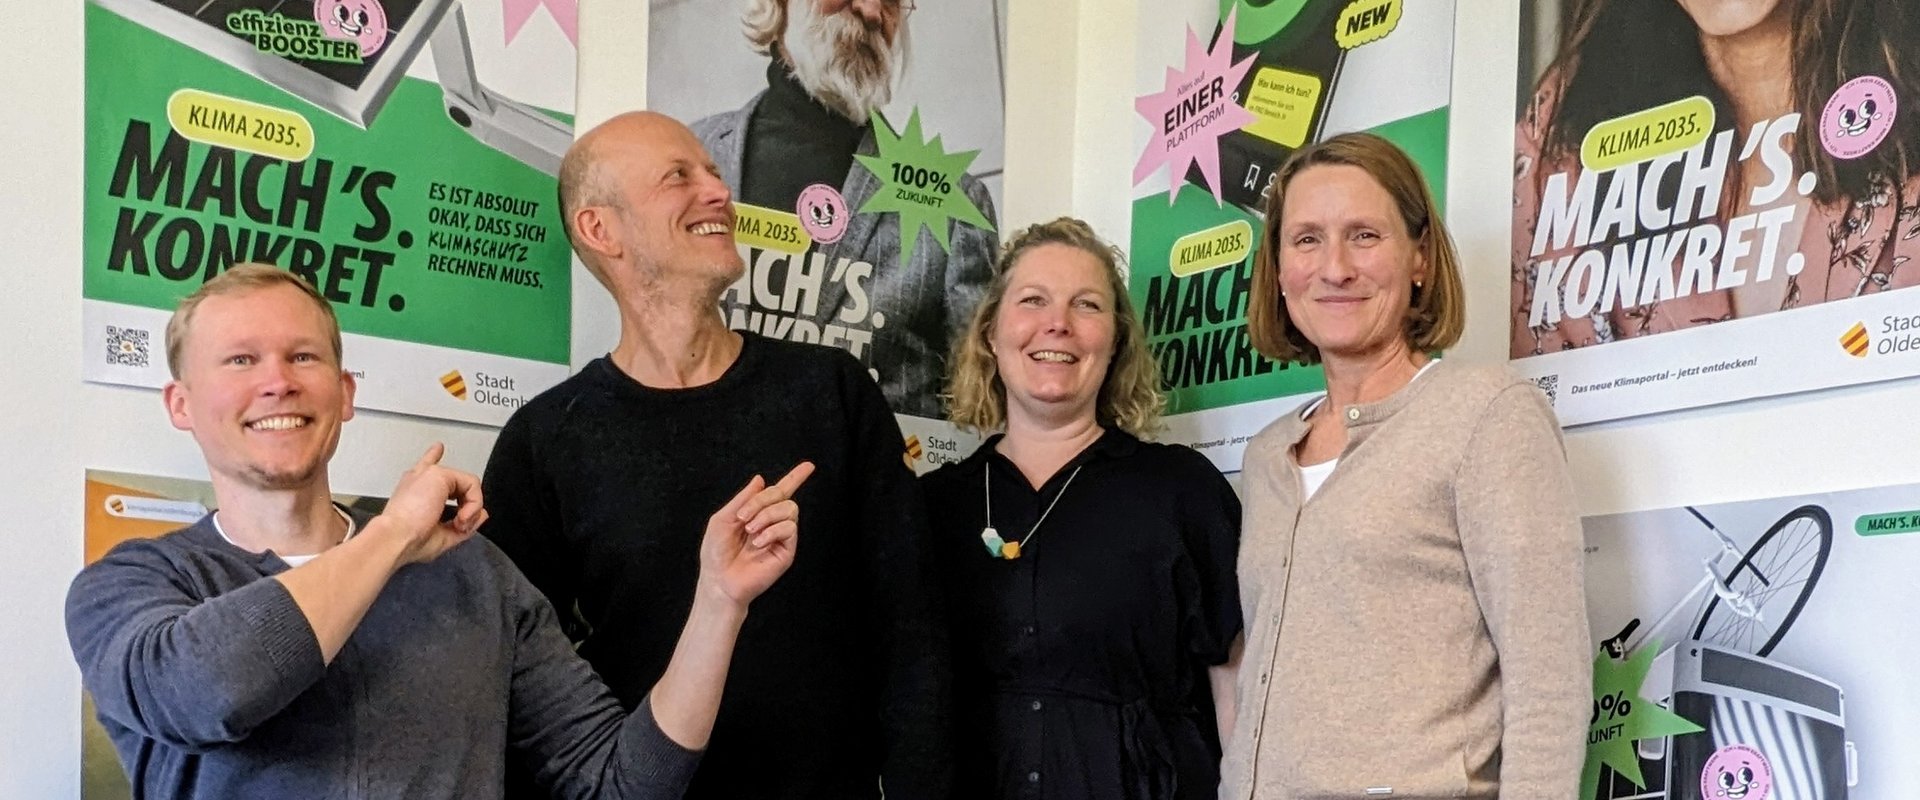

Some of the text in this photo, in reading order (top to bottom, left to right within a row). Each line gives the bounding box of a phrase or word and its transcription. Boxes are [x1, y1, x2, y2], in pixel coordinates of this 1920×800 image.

[228, 12, 321, 38] effizienz
[1345, 1, 1392, 37] NEW
[258, 34, 358, 60] BOOSTER
[1164, 75, 1224, 136] EINER
[188, 104, 301, 148] KLIMA 2035.
[1166, 102, 1225, 153] PLATTFORM
[1597, 113, 1702, 159] KLIMA 2035.
[108, 118, 413, 249] MACH'S.
[891, 162, 951, 195] 100%
[1530, 112, 1817, 257] MACH'S.
[429, 182, 539, 219] ES IST ABSOLUT
[896, 188, 944, 208] ZUKUNFT
[428, 207, 547, 243] OKAY, DASS SICH
[764, 221, 801, 244] 2035.
[428, 230, 529, 263] KLIMASCHUTZ
[1180, 232, 1244, 266] KLIMA 2035.
[427, 253, 543, 289] RECHNEN MUSS.
[1528, 205, 1805, 328] KONKRET.
[475, 372, 515, 391] Stadt
[1571, 384, 1588, 395] Das
[1589, 381, 1613, 392] neue
[1613, 370, 1670, 388] Klimaportal
[1676, 366, 1700, 380] jetzt
[1702, 356, 1758, 374] entdecken!
[928, 436, 957, 451] Stadt
[1867, 516, 1910, 531] MACH'S.
